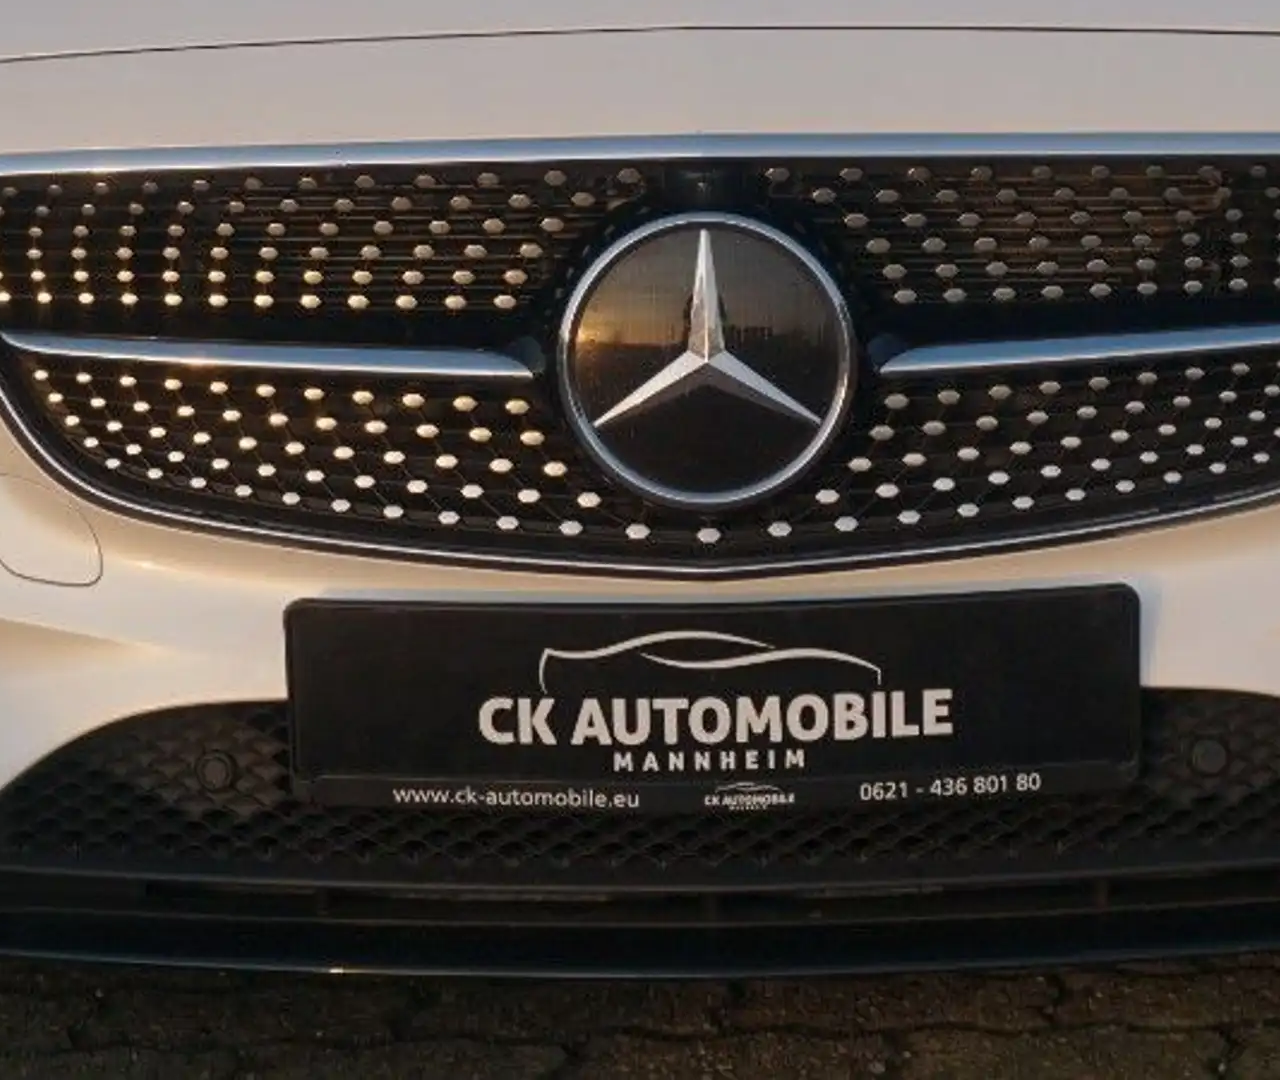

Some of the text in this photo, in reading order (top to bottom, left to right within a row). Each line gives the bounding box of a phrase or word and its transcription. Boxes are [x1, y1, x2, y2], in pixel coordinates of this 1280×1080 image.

[478, 689, 953, 746] CK AUTOMOBILE
[613, 748, 805, 772] MANNHEIM
[392, 785, 640, 808] www.ck-automobile.eu
[859, 781, 908, 801] 0621
[930, 777, 968, 796] 436
[973, 775, 1008, 794] 801
[1016, 772, 1042, 791] 80
